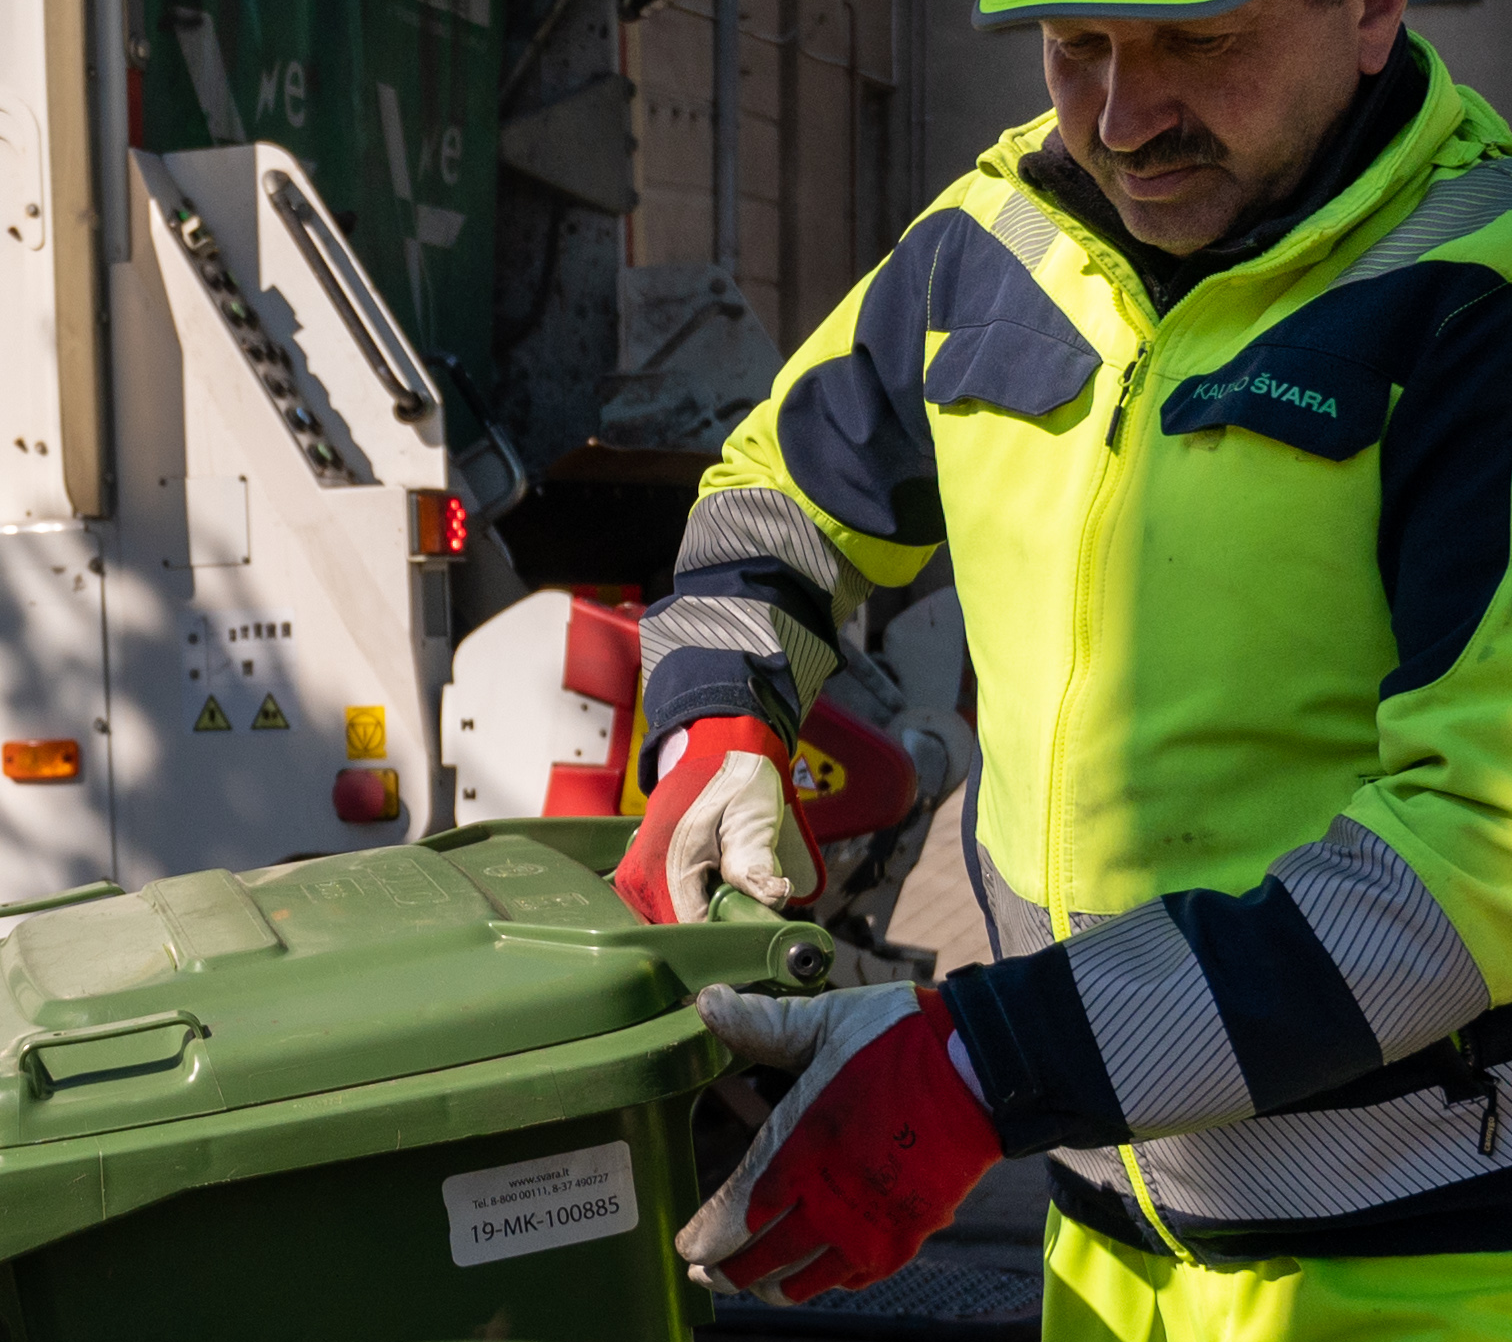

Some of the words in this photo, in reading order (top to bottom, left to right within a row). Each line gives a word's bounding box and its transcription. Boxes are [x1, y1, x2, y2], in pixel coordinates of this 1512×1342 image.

[1193, 376, 1249, 401] KAUO
[1250, 372, 1338, 419] ŠVARA
[472, 1199, 489, 1210] Tel.
[490, 1193, 517, 1206] 8-800
[519, 1186, 551, 1200] 00111,
[552, 1181, 573, 1194] 8-37
[576, 1172, 609, 1187] 490727
[508, 1167, 570, 1189] www.svara.lt
[470, 1195, 620, 1244] 19-MK-100885
